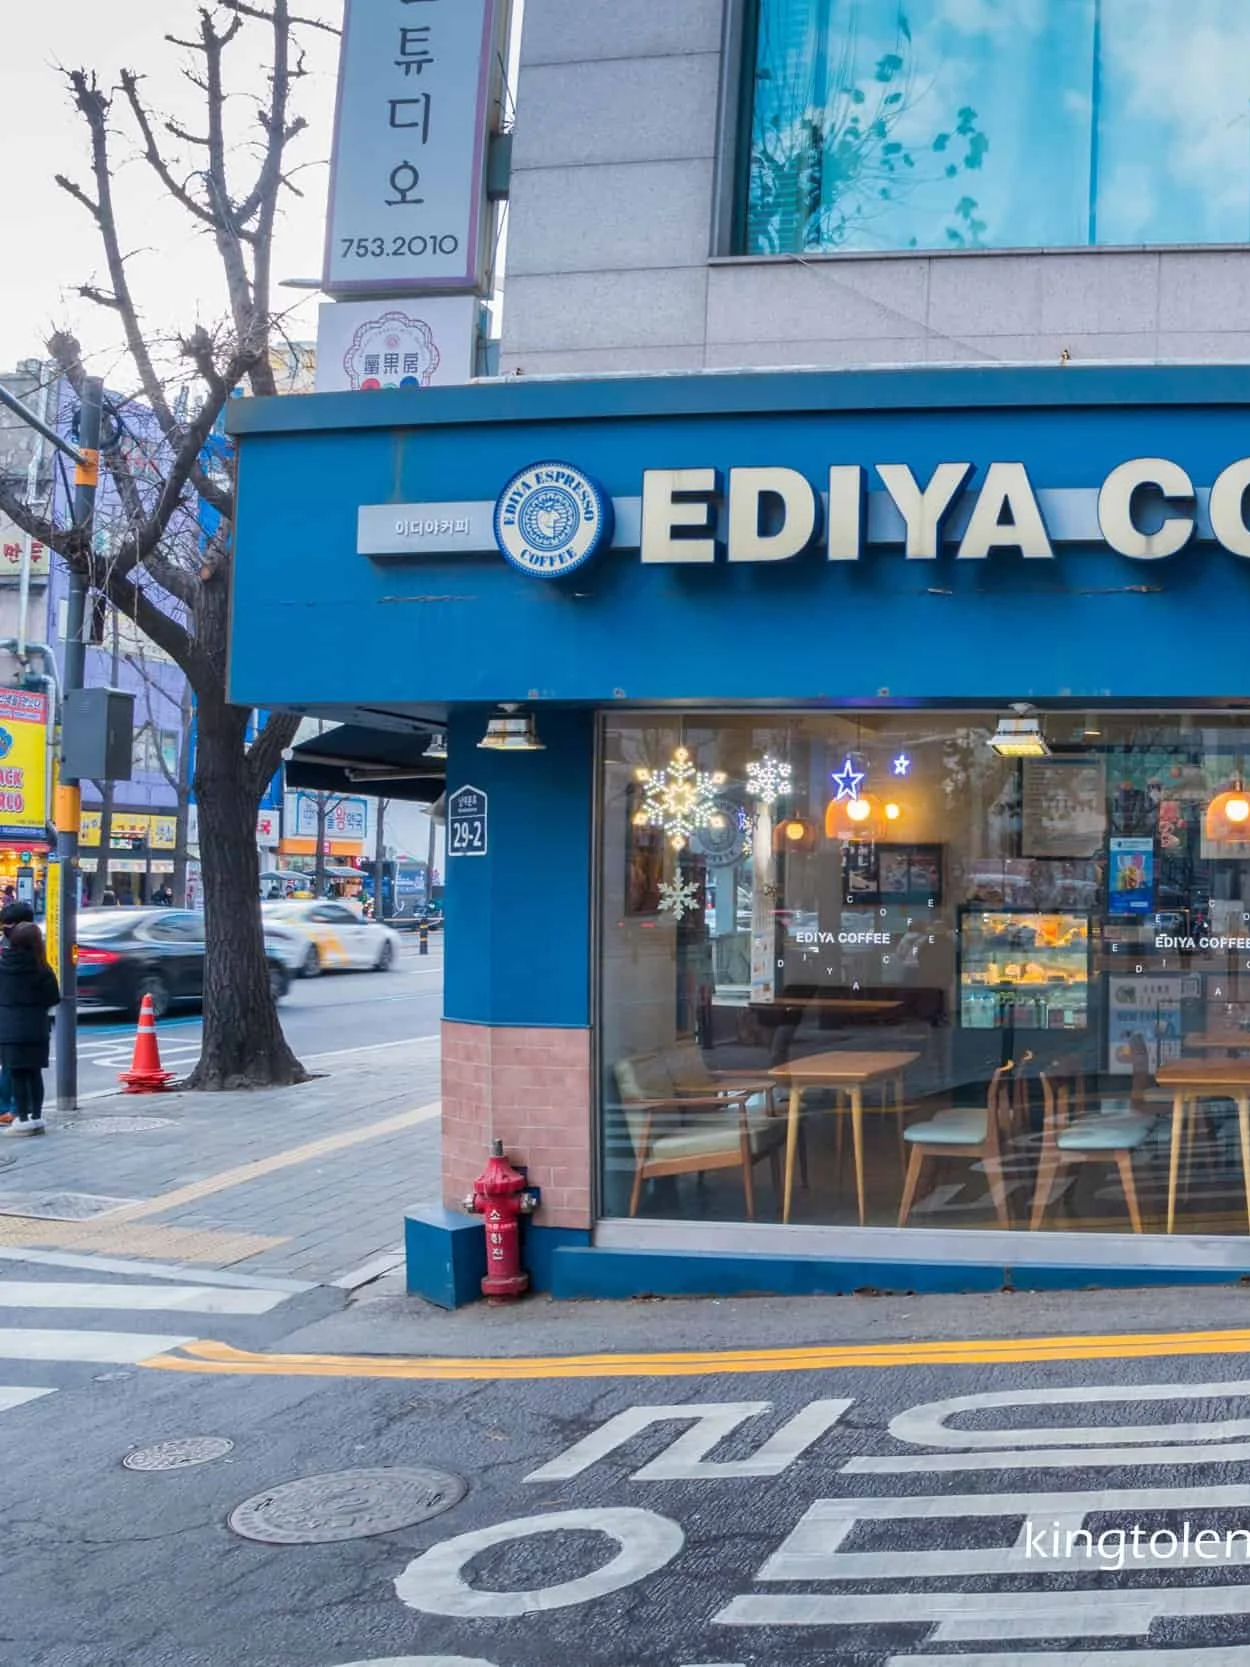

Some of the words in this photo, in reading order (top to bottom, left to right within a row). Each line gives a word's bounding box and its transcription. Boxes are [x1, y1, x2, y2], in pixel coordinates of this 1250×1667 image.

[384, 0, 440, 207] 튜디오
[341, 234, 459, 258] 753.2010
[504, 480, 532, 525] EDIYA
[534, 471, 594, 521] ESPRESSO
[641, 461, 1055, 563] EDIYA
[521, 548, 577, 567] COFFEE
[453, 821, 482, 848] 29-2
[796, 932, 835, 944] EDIYA
[838, 932, 891, 944] COFFEE
[1155, 937, 1196, 949] EDIYA
